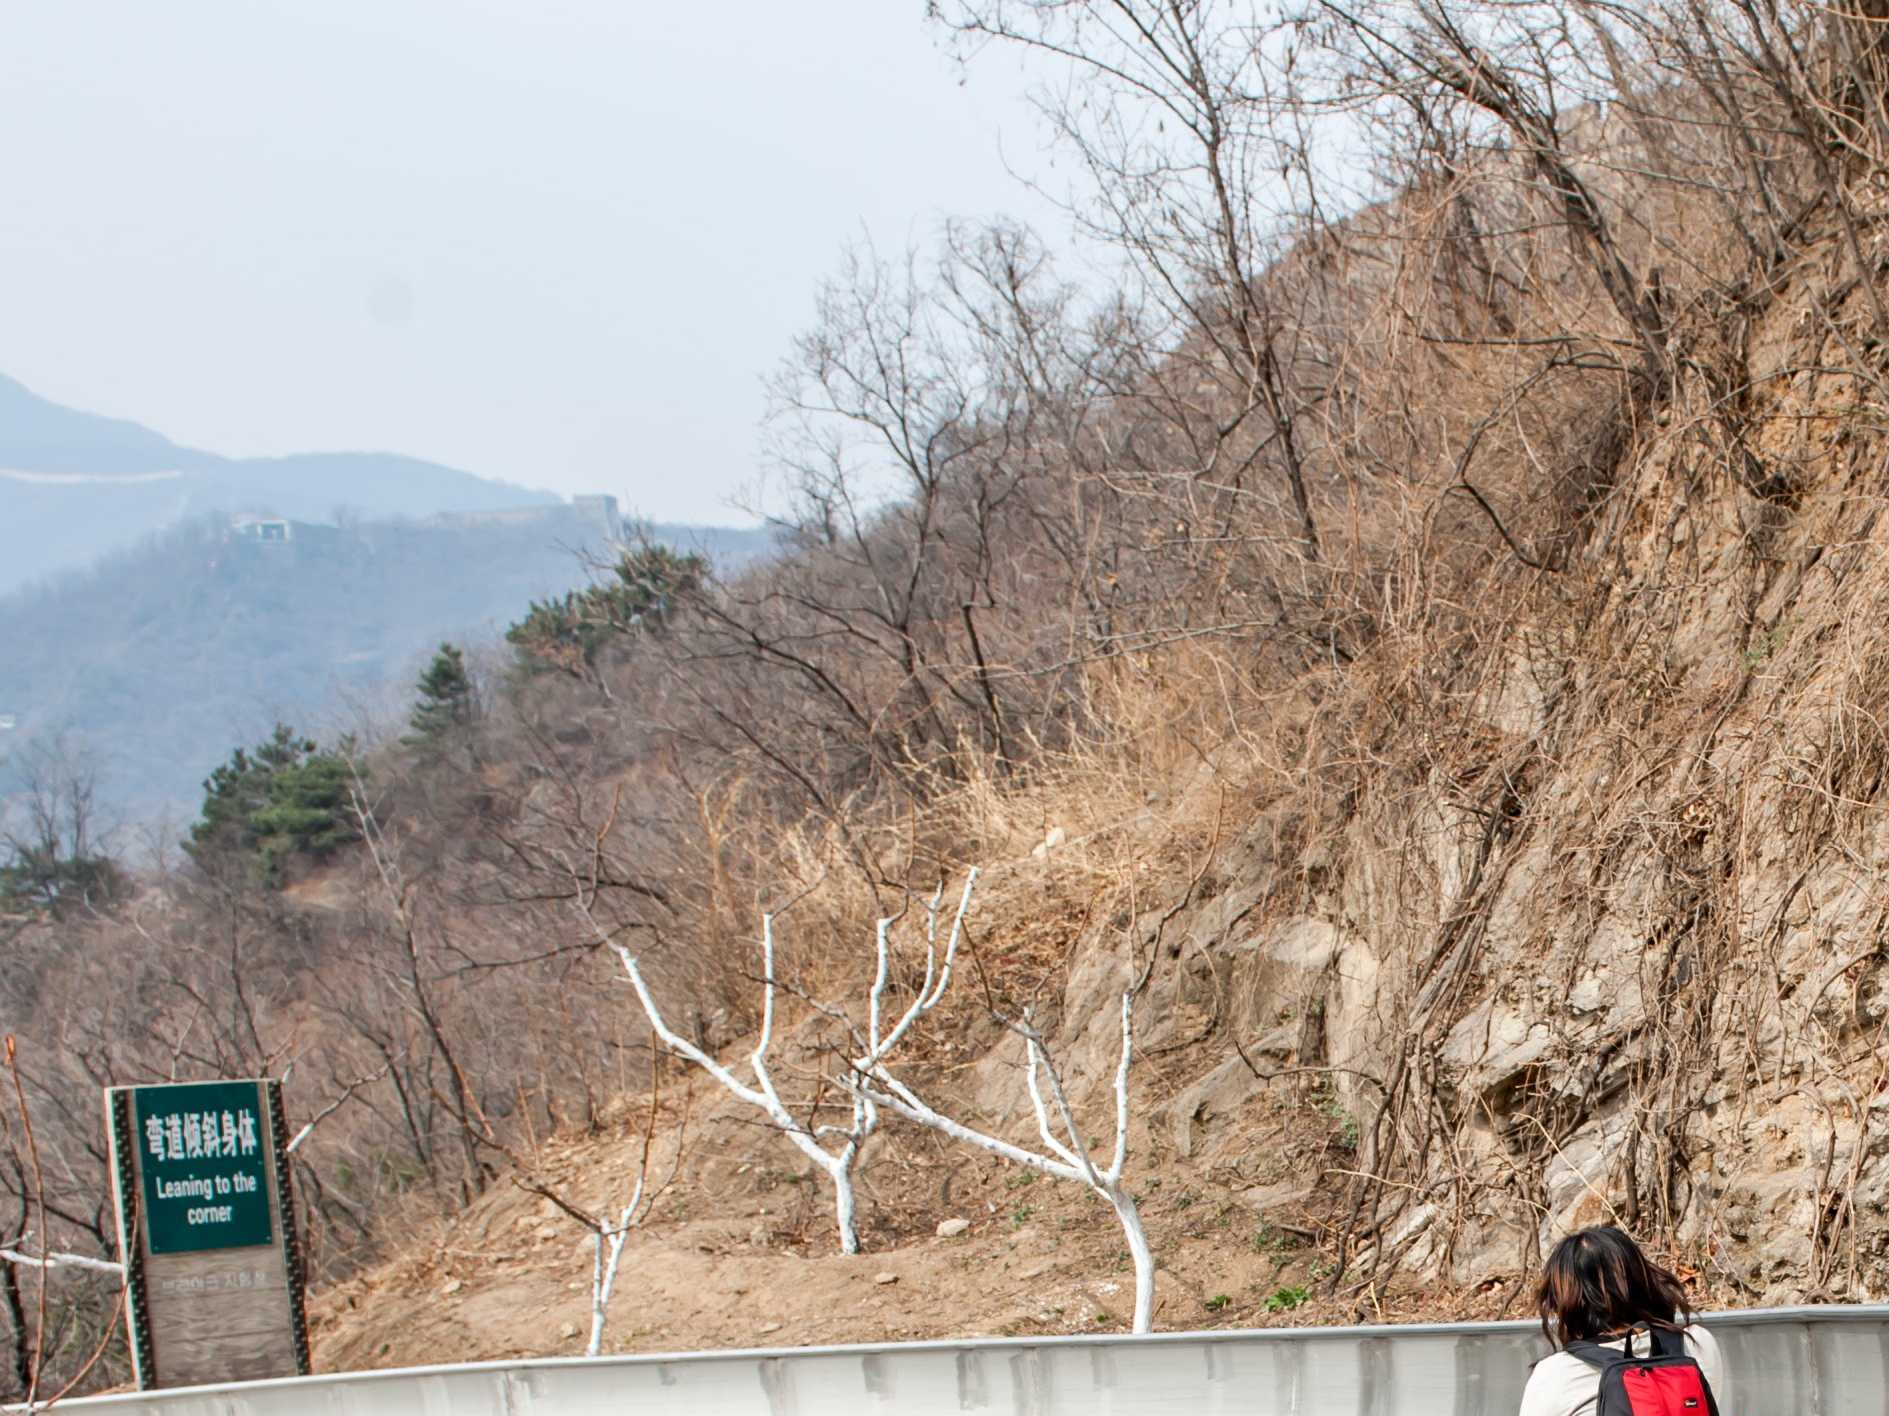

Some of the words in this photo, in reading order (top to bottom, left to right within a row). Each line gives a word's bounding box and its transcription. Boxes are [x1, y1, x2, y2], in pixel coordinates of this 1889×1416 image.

[145, 1109, 257, 1162] 弯道倾斜身体
[156, 1174, 212, 1200] Leaning
[215, 1175, 230, 1194] to
[233, 1171, 257, 1192] the
[187, 1205, 232, 1224] corner
